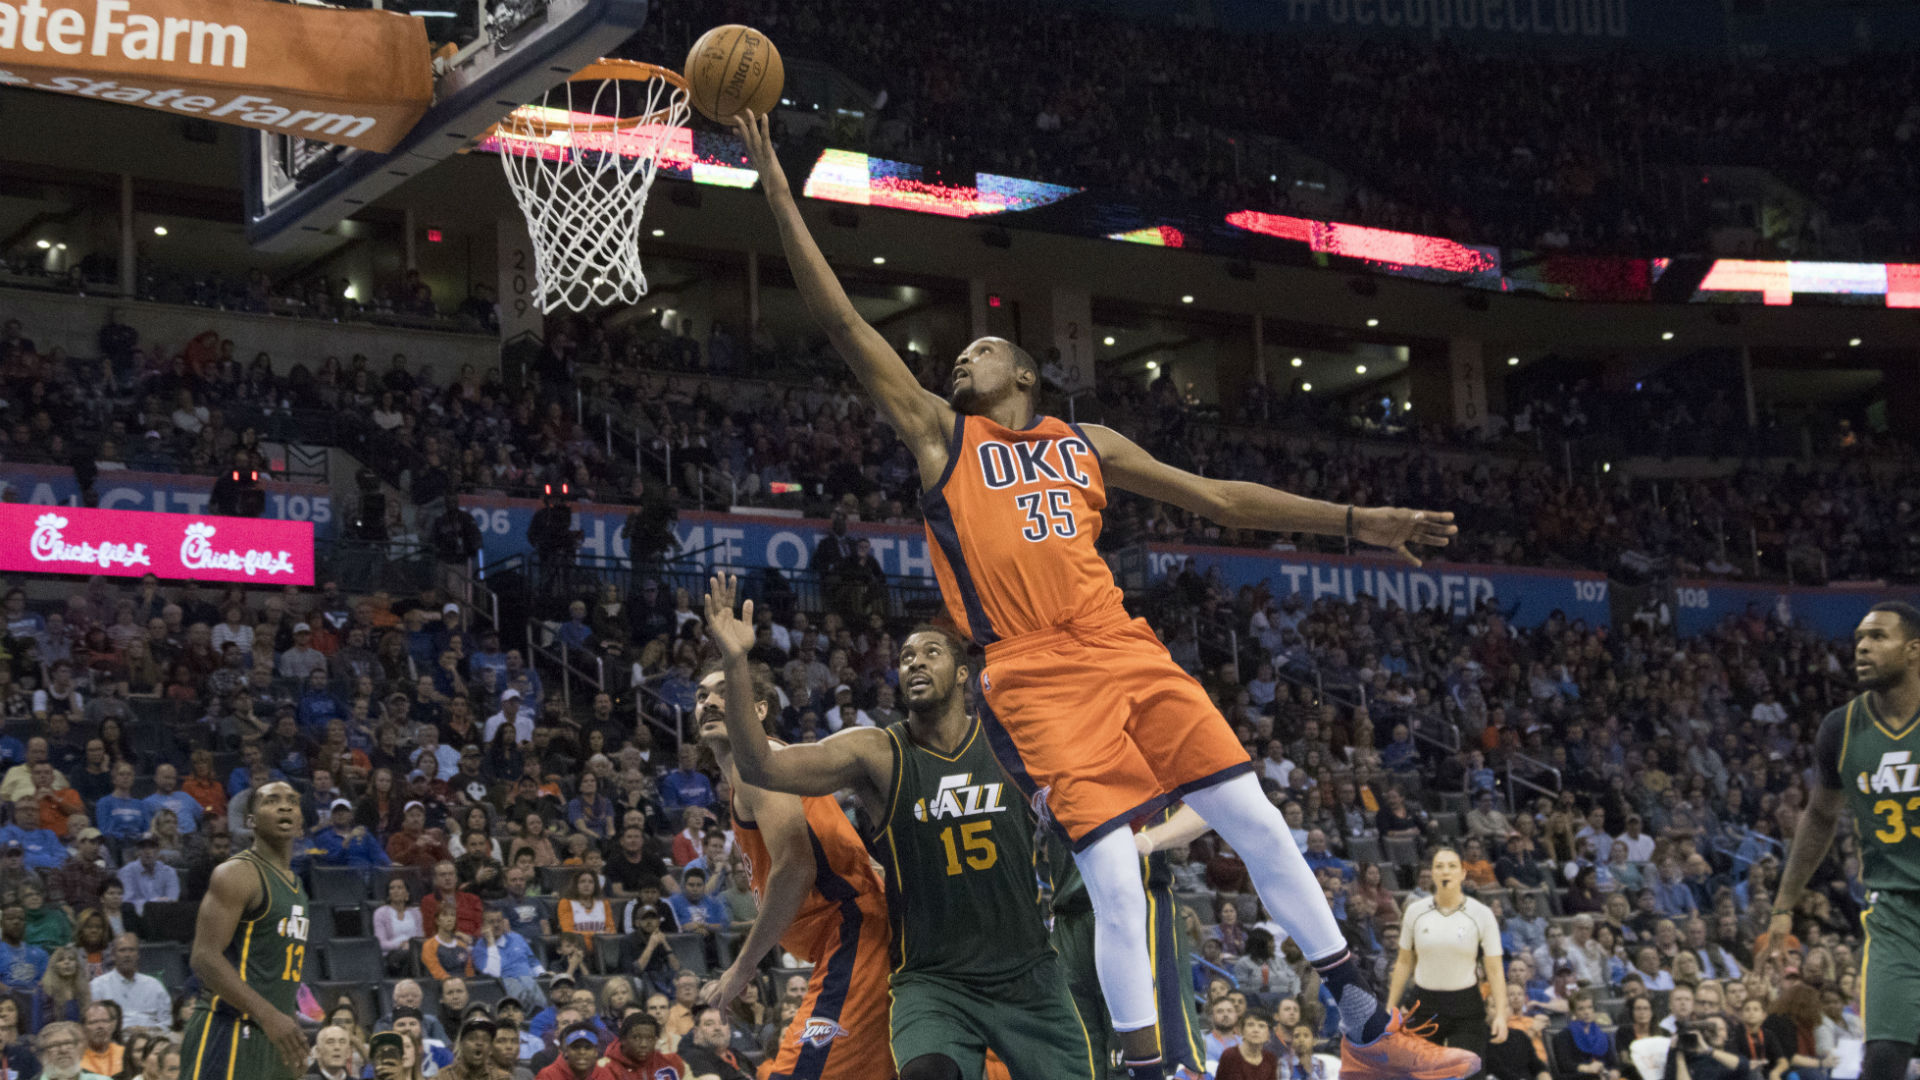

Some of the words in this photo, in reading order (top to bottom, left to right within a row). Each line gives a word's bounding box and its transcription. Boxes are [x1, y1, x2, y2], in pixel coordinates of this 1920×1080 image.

[91, 0, 248, 68] Farm
[725, 34, 760, 99] SPALDING
[36, 76, 217, 113] State
[208, 95, 377, 138] Farm
[513, 250, 526, 319] 209
[977, 436, 1091, 490] OKC
[273, 494, 331, 523] 105
[1015, 489, 1077, 543] 35
[866, 538, 933, 586] TH
[1573, 580, 1607, 603] 107
[1676, 587, 1710, 609] 108
[940, 820, 998, 876] 15
[281, 943, 305, 983] 13
